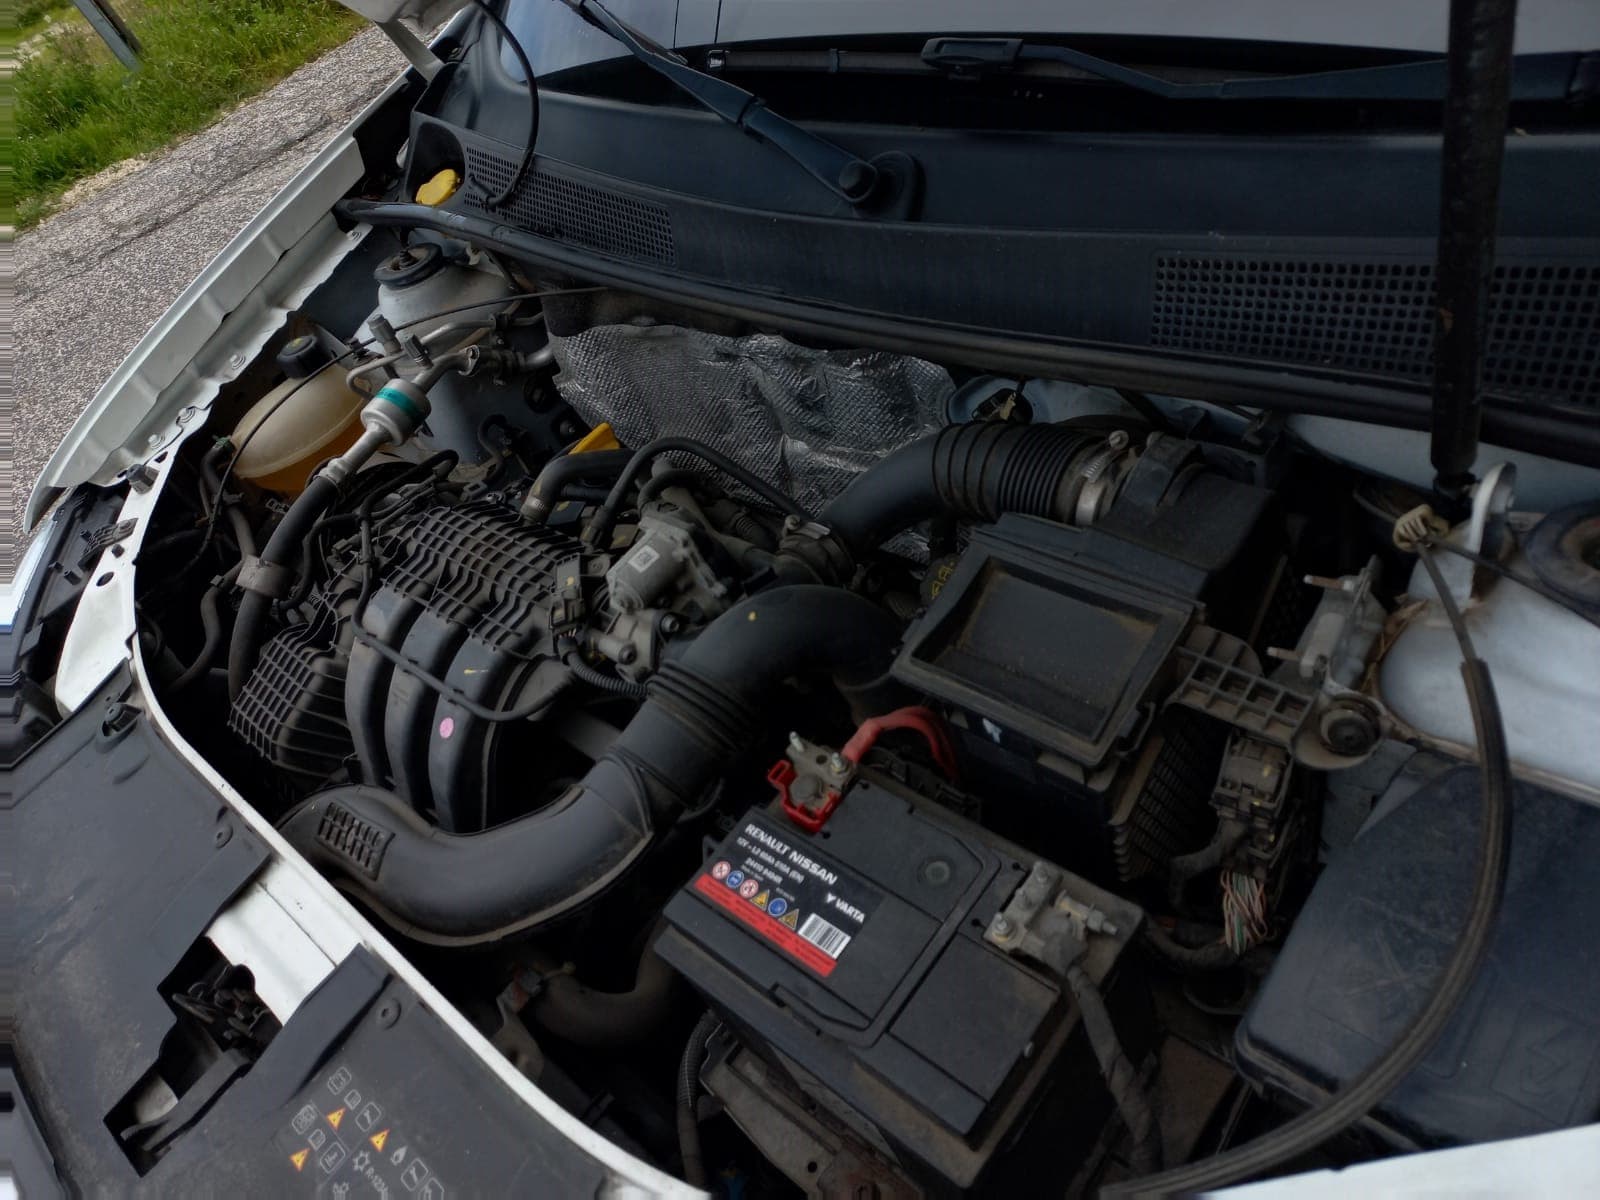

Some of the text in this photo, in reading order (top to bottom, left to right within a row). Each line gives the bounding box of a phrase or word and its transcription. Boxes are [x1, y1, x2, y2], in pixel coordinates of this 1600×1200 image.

[744, 823, 791, 855] RENAULT
[788, 850, 838, 885] NISSAN
[835, 898, 866, 923] VARTA
